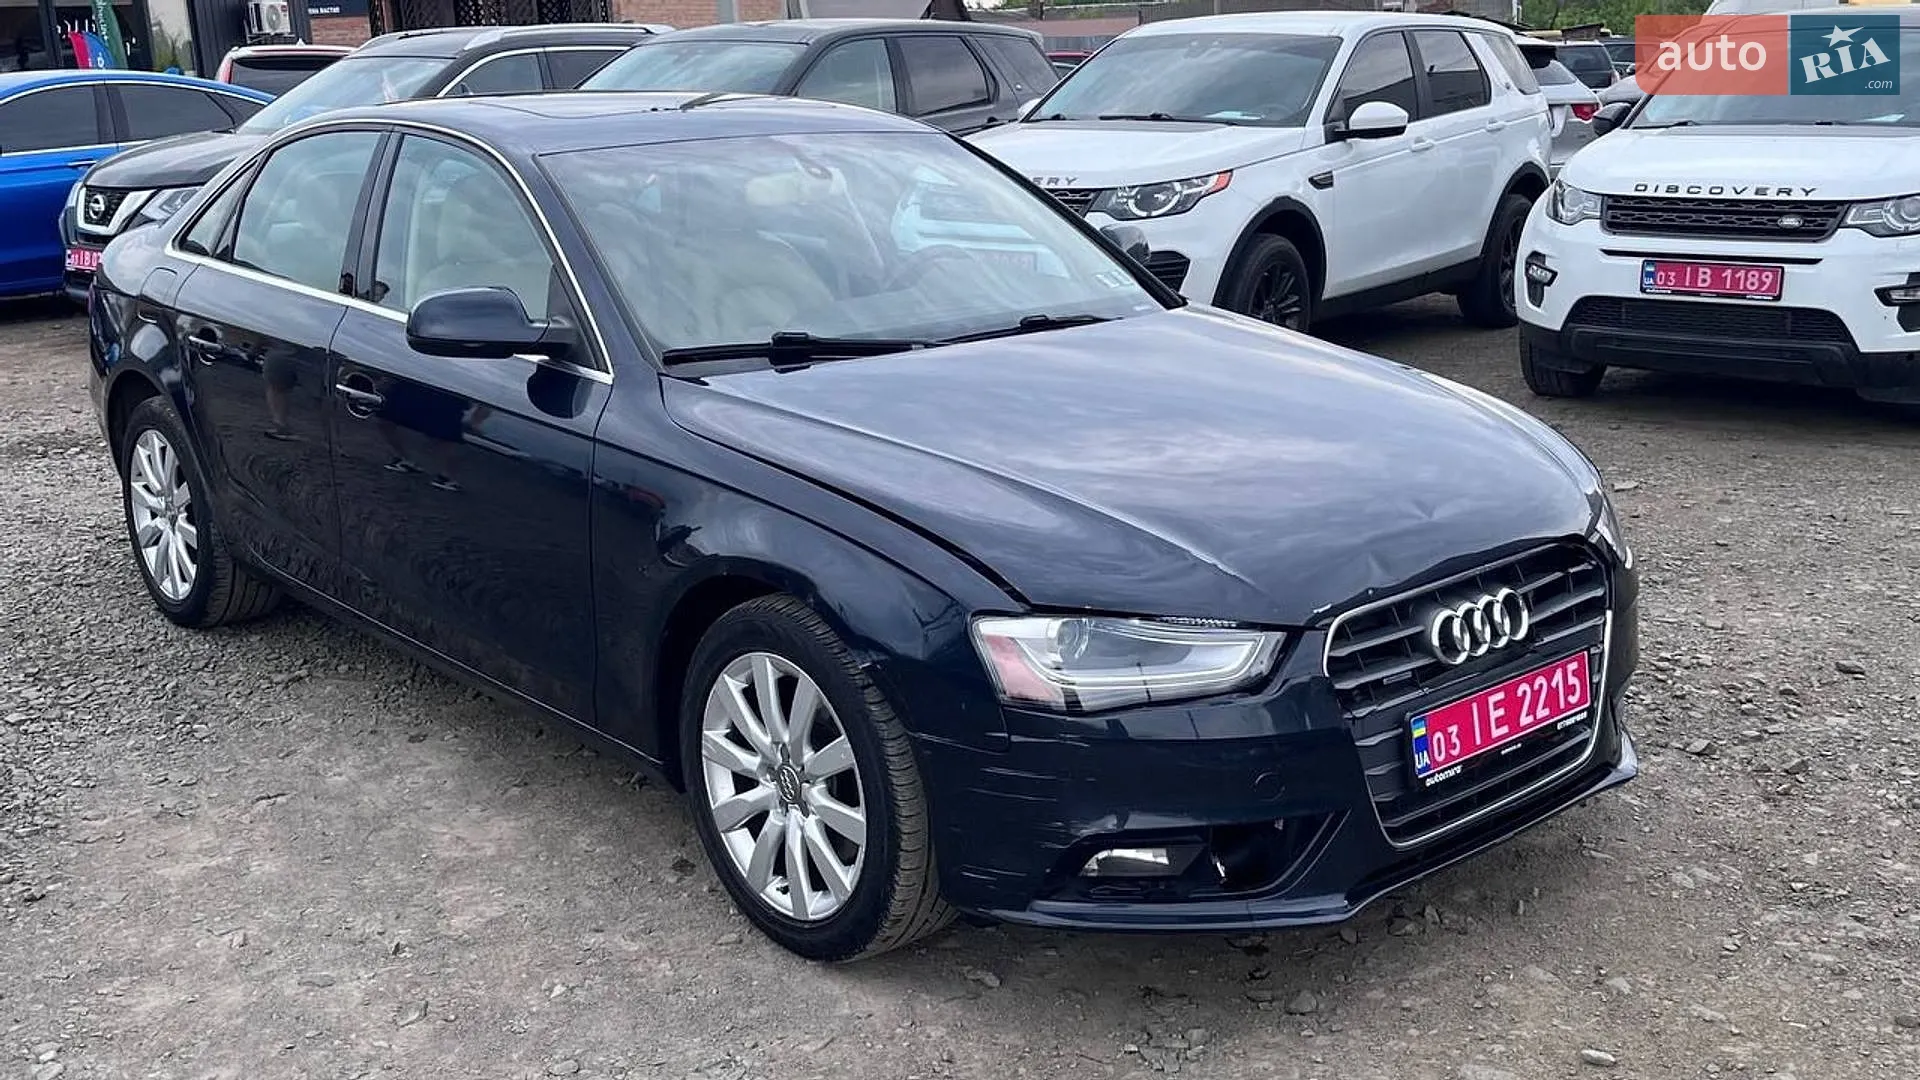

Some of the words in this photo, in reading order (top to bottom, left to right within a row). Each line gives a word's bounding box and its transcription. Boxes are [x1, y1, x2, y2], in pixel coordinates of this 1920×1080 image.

[1634, 184, 1817, 197] DISCOVERY
[1656, 271, 1676, 286] 03
[1685, 266, 1712, 288] IB
[1721, 268, 1773, 291] 1189
[1432, 724, 1461, 762] 03
[1471, 691, 1510, 746] IE
[1516, 661, 1581, 728] 2215
[1415, 750, 1431, 769] UA
